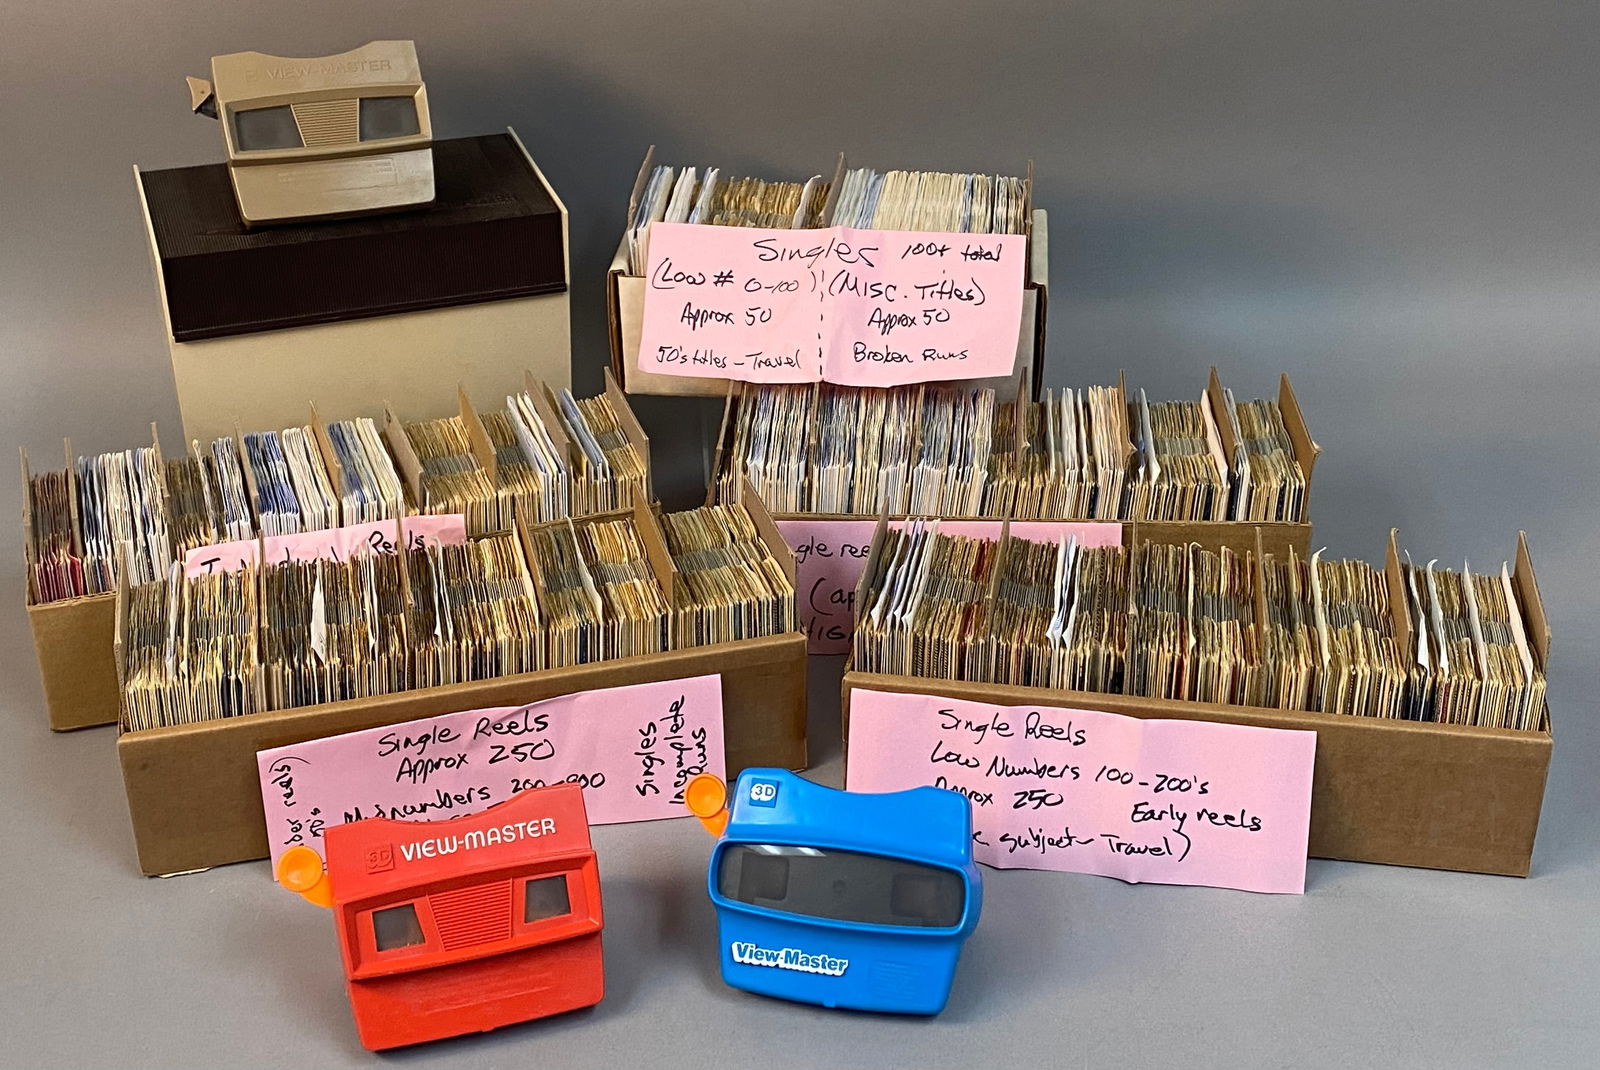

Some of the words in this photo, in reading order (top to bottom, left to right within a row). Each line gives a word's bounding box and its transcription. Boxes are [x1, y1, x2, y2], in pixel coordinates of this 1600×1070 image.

[265, 59, 392, 81] VIEW-MASTER
[753, 237, 879, 267] Singles
[652, 257, 706, 290] (Low
[681, 302, 735, 332] Approx
[744, 309, 773, 325] 50
[867, 309, 917, 336] Approx
[922, 309, 951, 325] 50
[853, 341, 914, 363] Broken
[369, 529, 426, 555] Rels
[377, 724, 461, 756] Single
[473, 710, 550, 741] Reels
[938, 709, 1014, 744] Single
[1024, 711, 1087, 746] Reels
[396, 753, 470, 786] Approx
[488, 738, 556, 766] 250
[634, 721, 665, 797] Singles
[930, 740, 980, 764] Low
[986, 755, 1081, 780] Numbers
[755, 785, 775, 797] 3D
[1013, 789, 1064, 809] 250
[1132, 802, 1187, 834] Early
[1196, 806, 1262, 832] reels
[400, 817, 556, 862] VIEW-MASTER
[734, 943, 847, 973] View-Master
